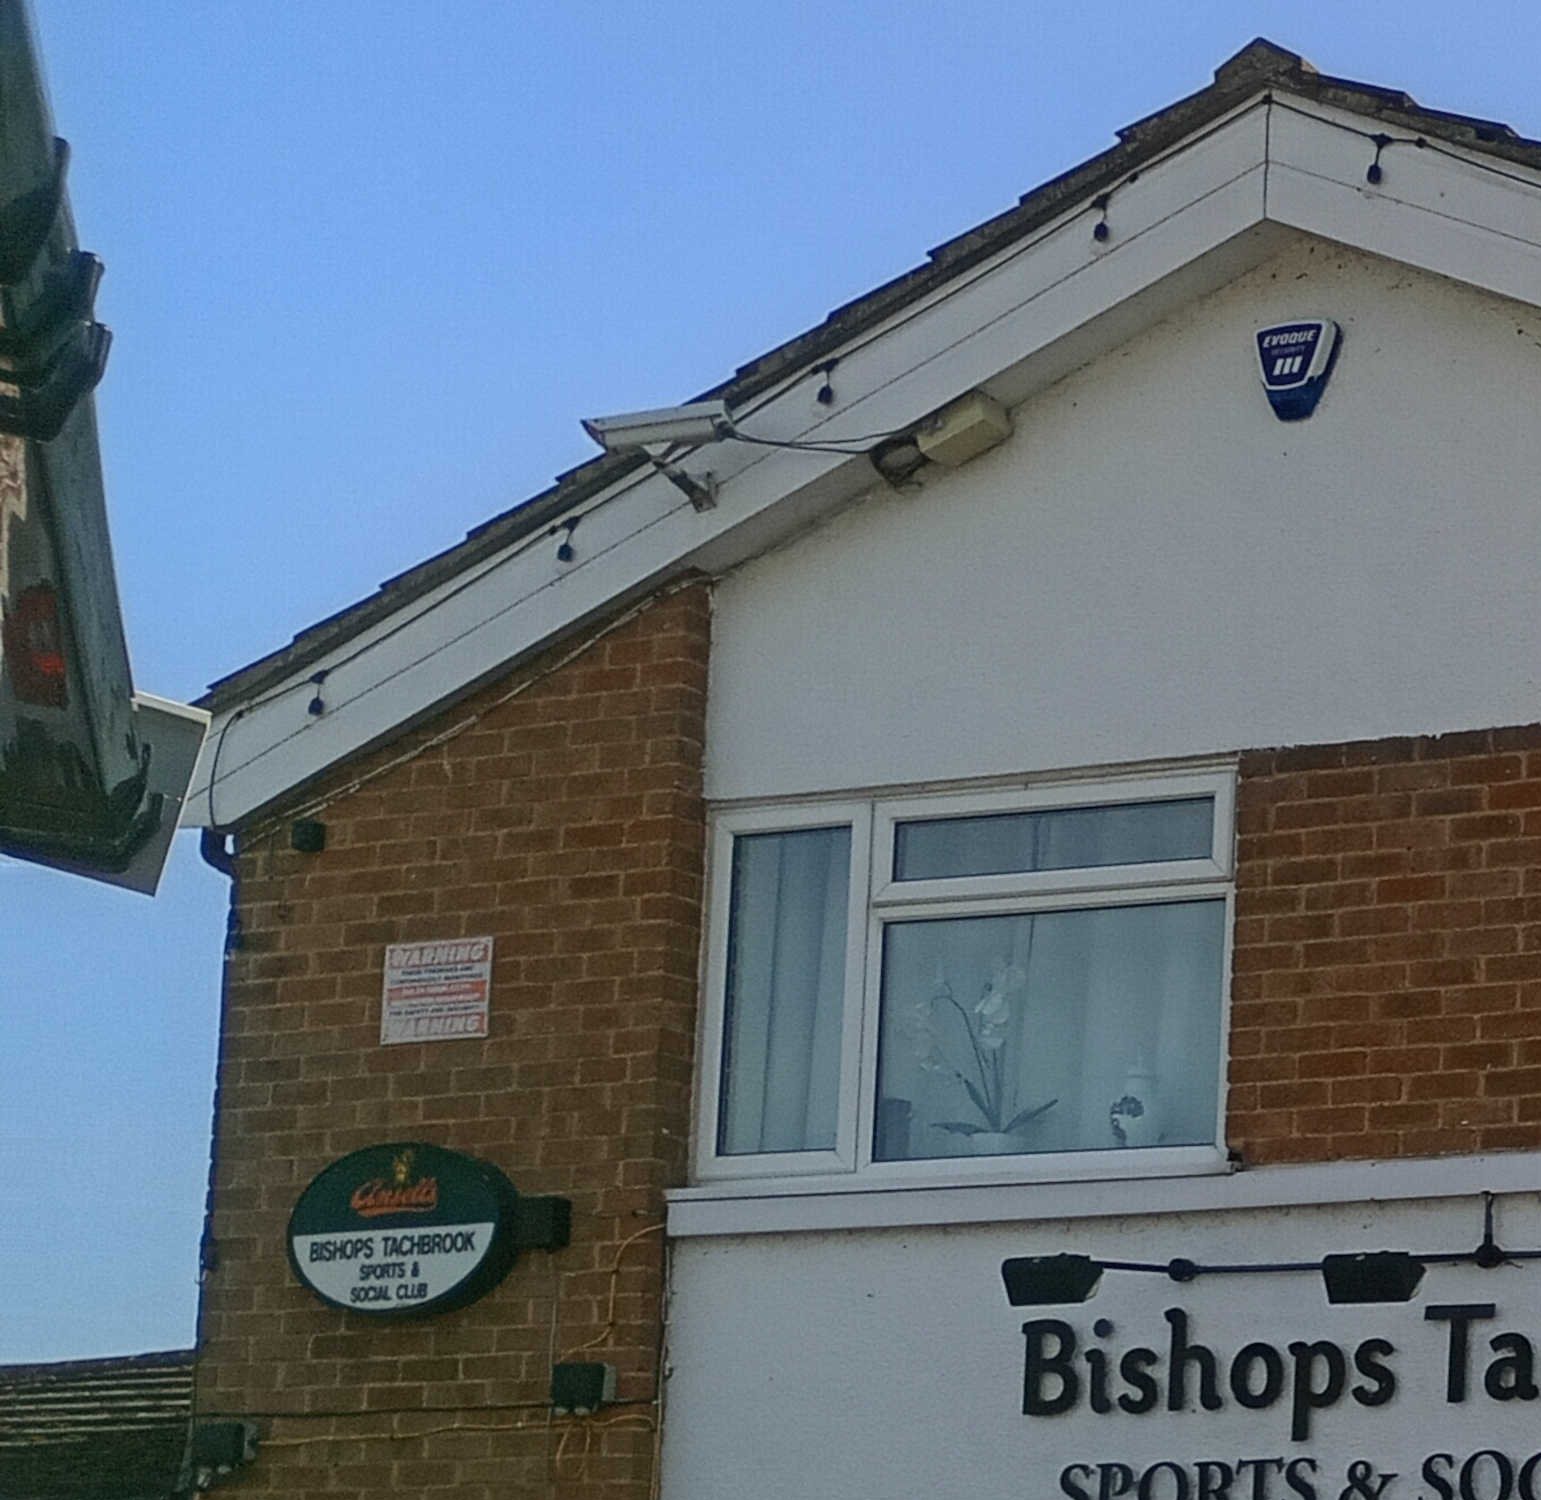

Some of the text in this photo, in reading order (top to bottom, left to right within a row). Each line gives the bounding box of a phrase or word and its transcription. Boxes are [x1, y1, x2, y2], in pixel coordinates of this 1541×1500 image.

[1263, 329, 1317, 347] EVOQUE
[390, 943, 485, 967] WARNING
[309, 1230, 476, 1262] BISHOPS TACHBROOK
[359, 1260, 420, 1281] SPORTS &
[350, 1283, 428, 1303] SOCIAL CLUB
[1021, 1307, 1398, 1442] Bishops
